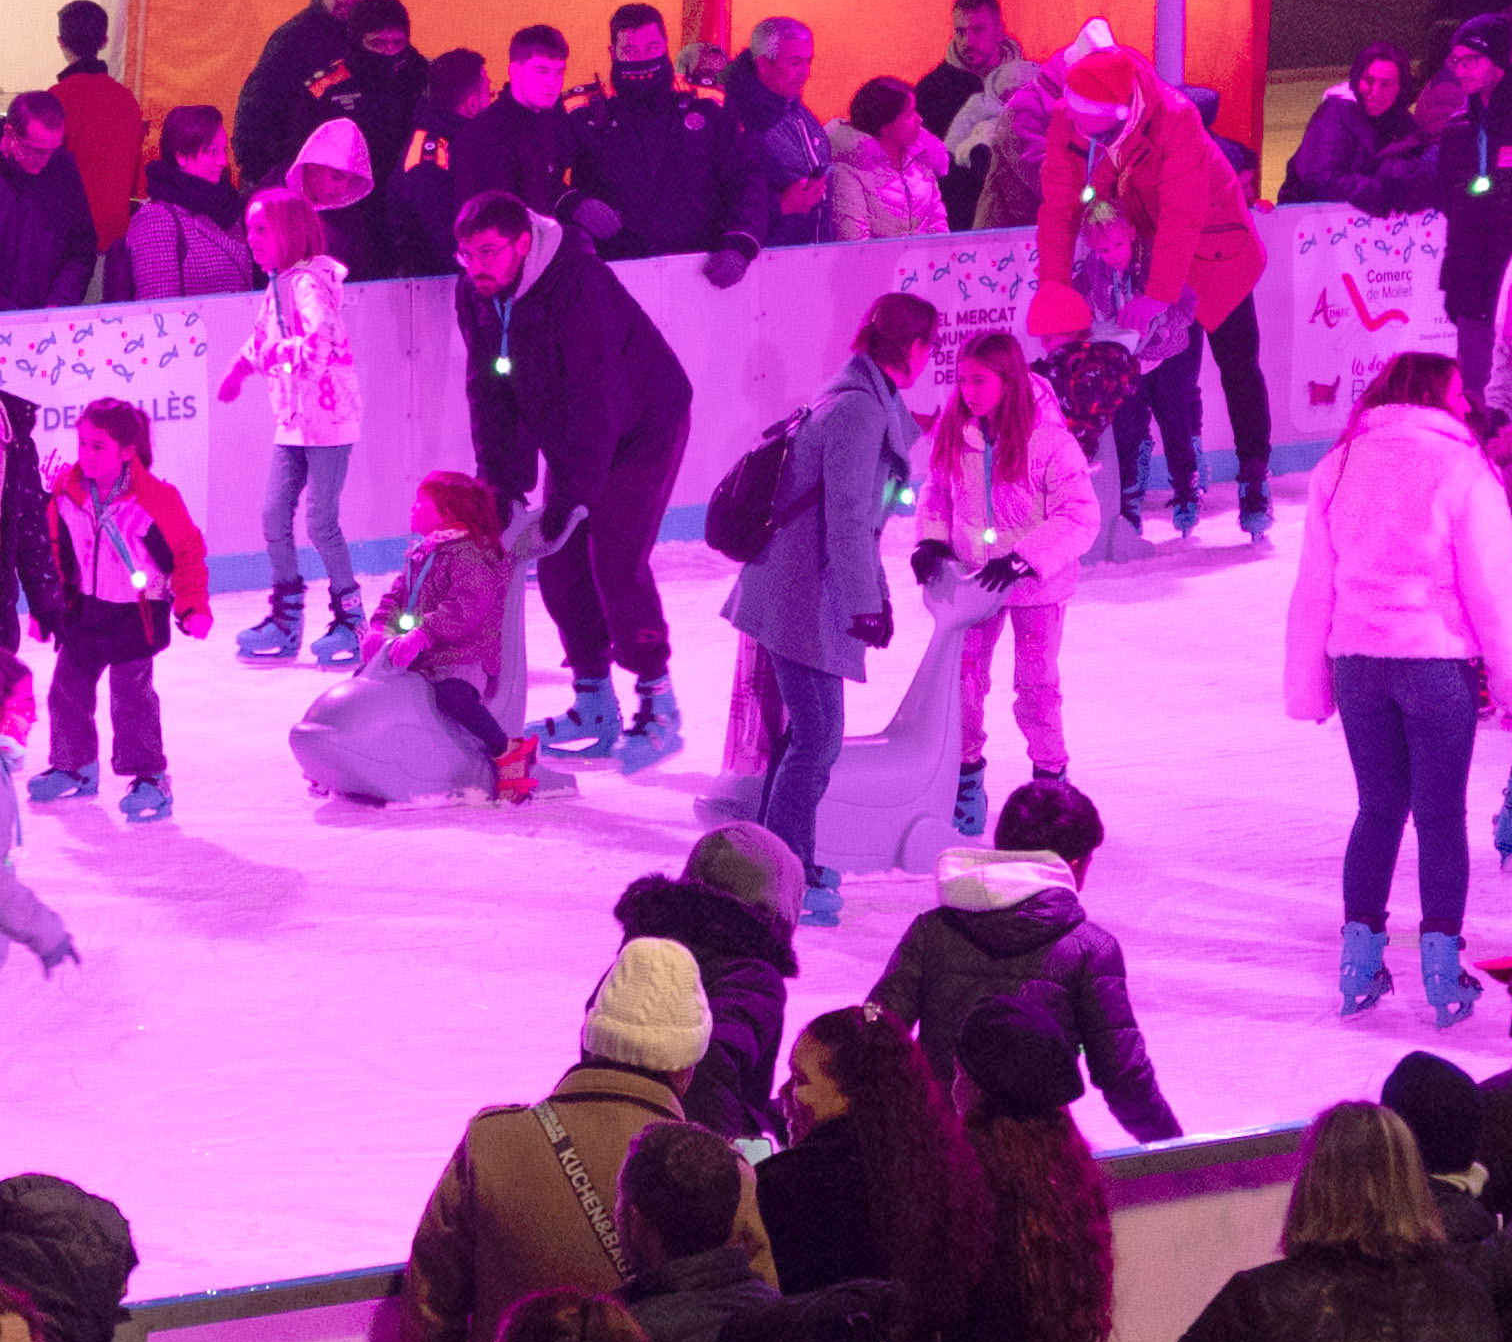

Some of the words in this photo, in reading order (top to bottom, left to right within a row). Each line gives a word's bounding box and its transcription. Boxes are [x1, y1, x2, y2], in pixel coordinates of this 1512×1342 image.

[1367, 269, 1414, 285] Comerç
[937, 311, 952, 328] EL
[956, 306, 1017, 327] MERCAT
[43, 404, 85, 431] DE
